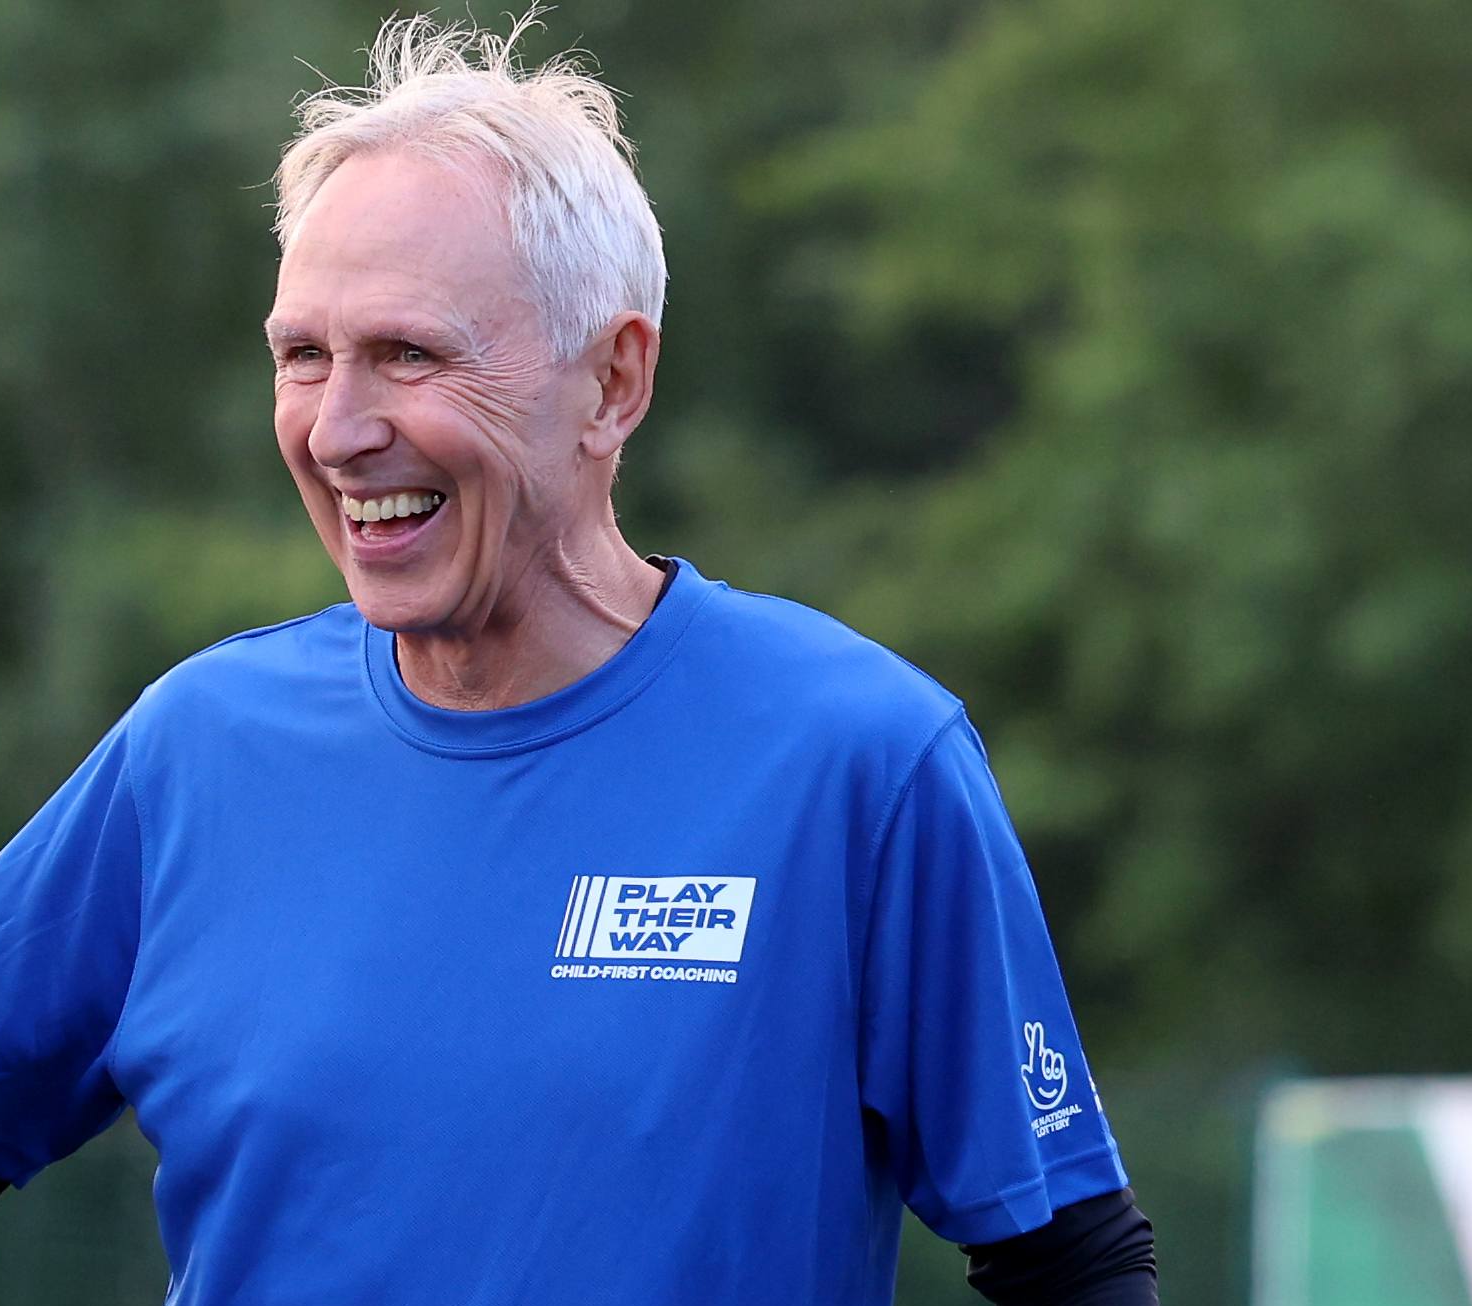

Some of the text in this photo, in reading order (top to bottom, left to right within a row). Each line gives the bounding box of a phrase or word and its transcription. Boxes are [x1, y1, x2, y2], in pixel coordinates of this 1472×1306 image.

[617, 883, 728, 904] PLAY
[613, 908, 736, 929] THEIR
[609, 931, 693, 952] WAY
[551, 965, 738, 983] CHILD-FIRST COACHING
[1039, 1104, 1082, 1127] NATIONAL
[1036, 1117, 1070, 1138] LOTTERY
